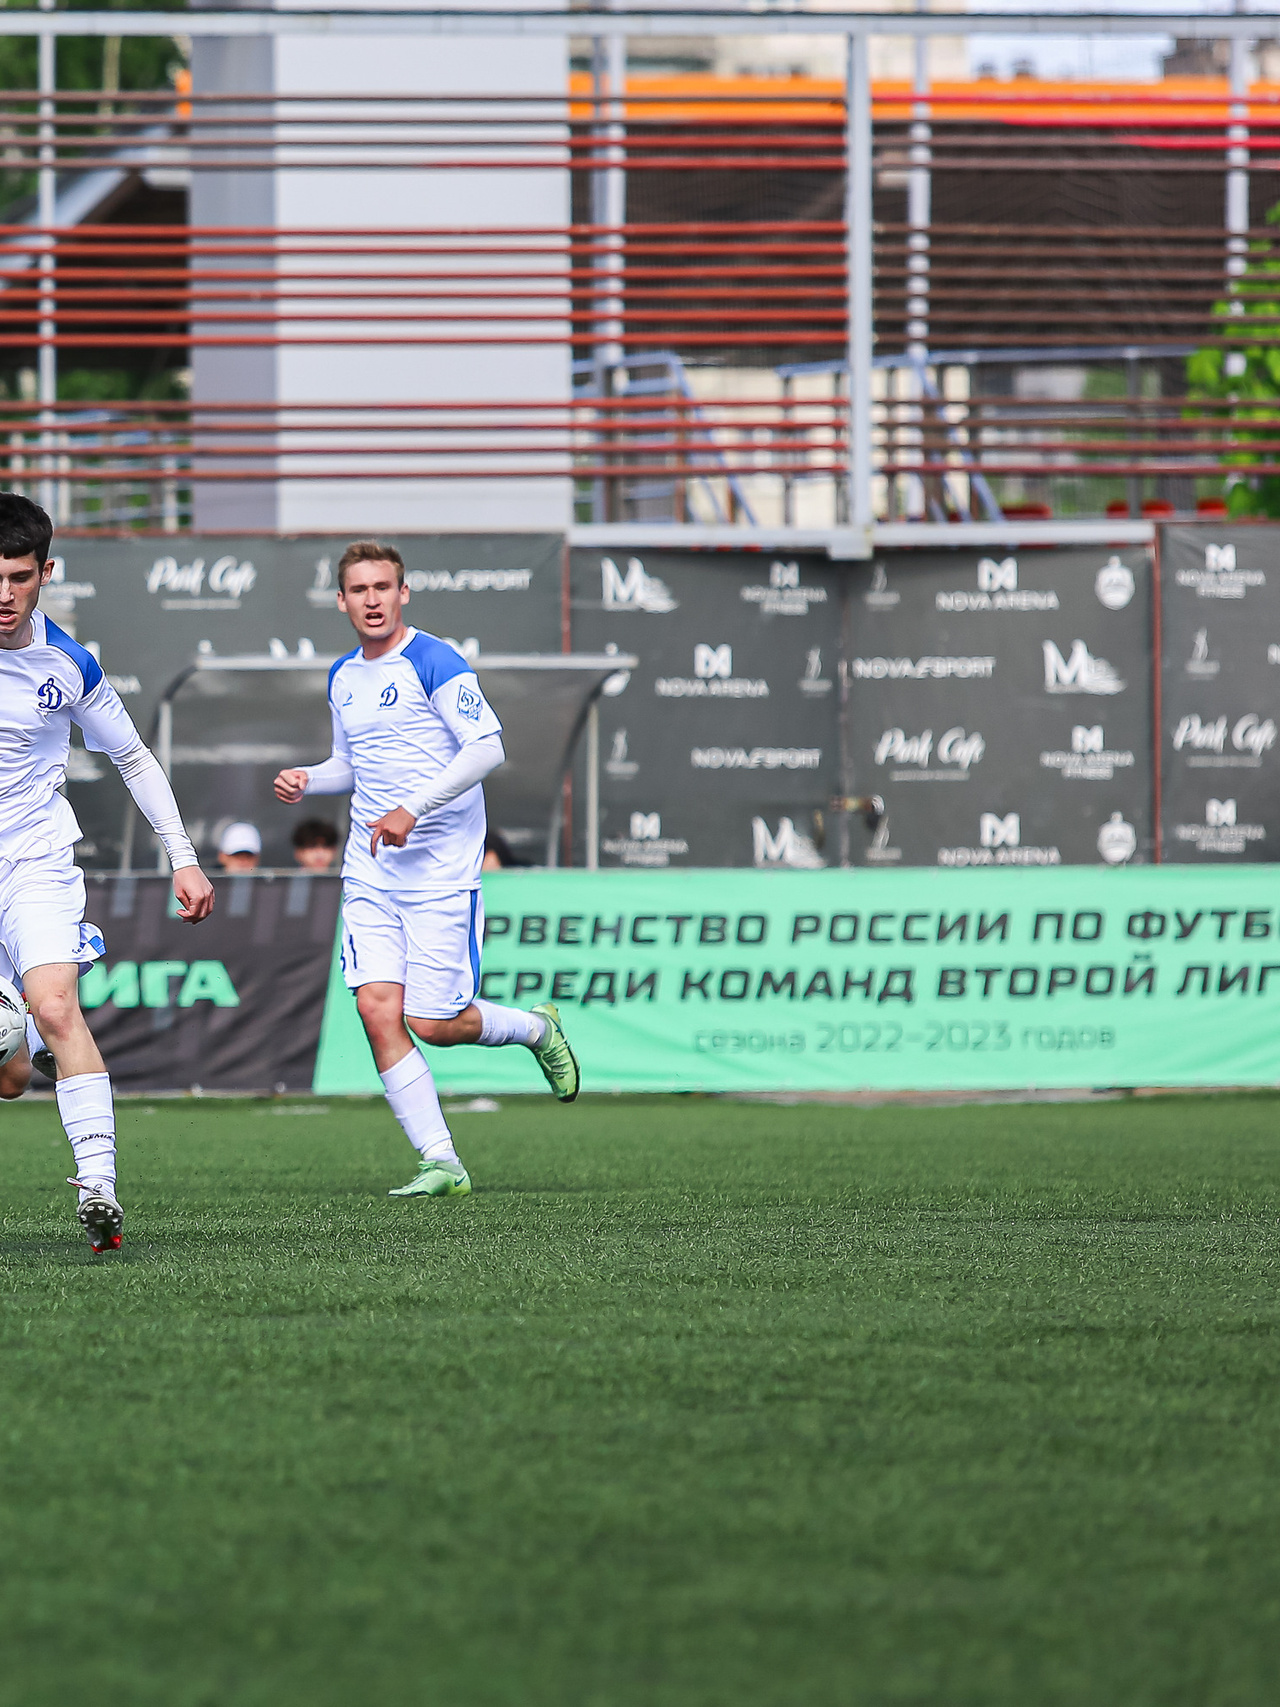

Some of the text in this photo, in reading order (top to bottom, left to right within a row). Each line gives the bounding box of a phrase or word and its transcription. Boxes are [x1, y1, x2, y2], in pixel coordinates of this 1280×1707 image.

[935, 589, 1060, 612] NOVA ARENA
[654, 676, 769, 698] NOVA ARENA
[937, 846, 1061, 866] NOVA ARENA
[484, 909, 1280, 945] РВЕНСТВО РОССИИ ПО ФУТБ
[80, 960, 241, 1008] ИГА
[481, 970, 658, 1007] СРЕДИ
[680, 967, 916, 1005] КОМАНД
[936, 952, 1158, 997] ВТОРОЙ
[695, 1031, 806, 1054] сезона
[1022, 1024, 1116, 1052] годов
